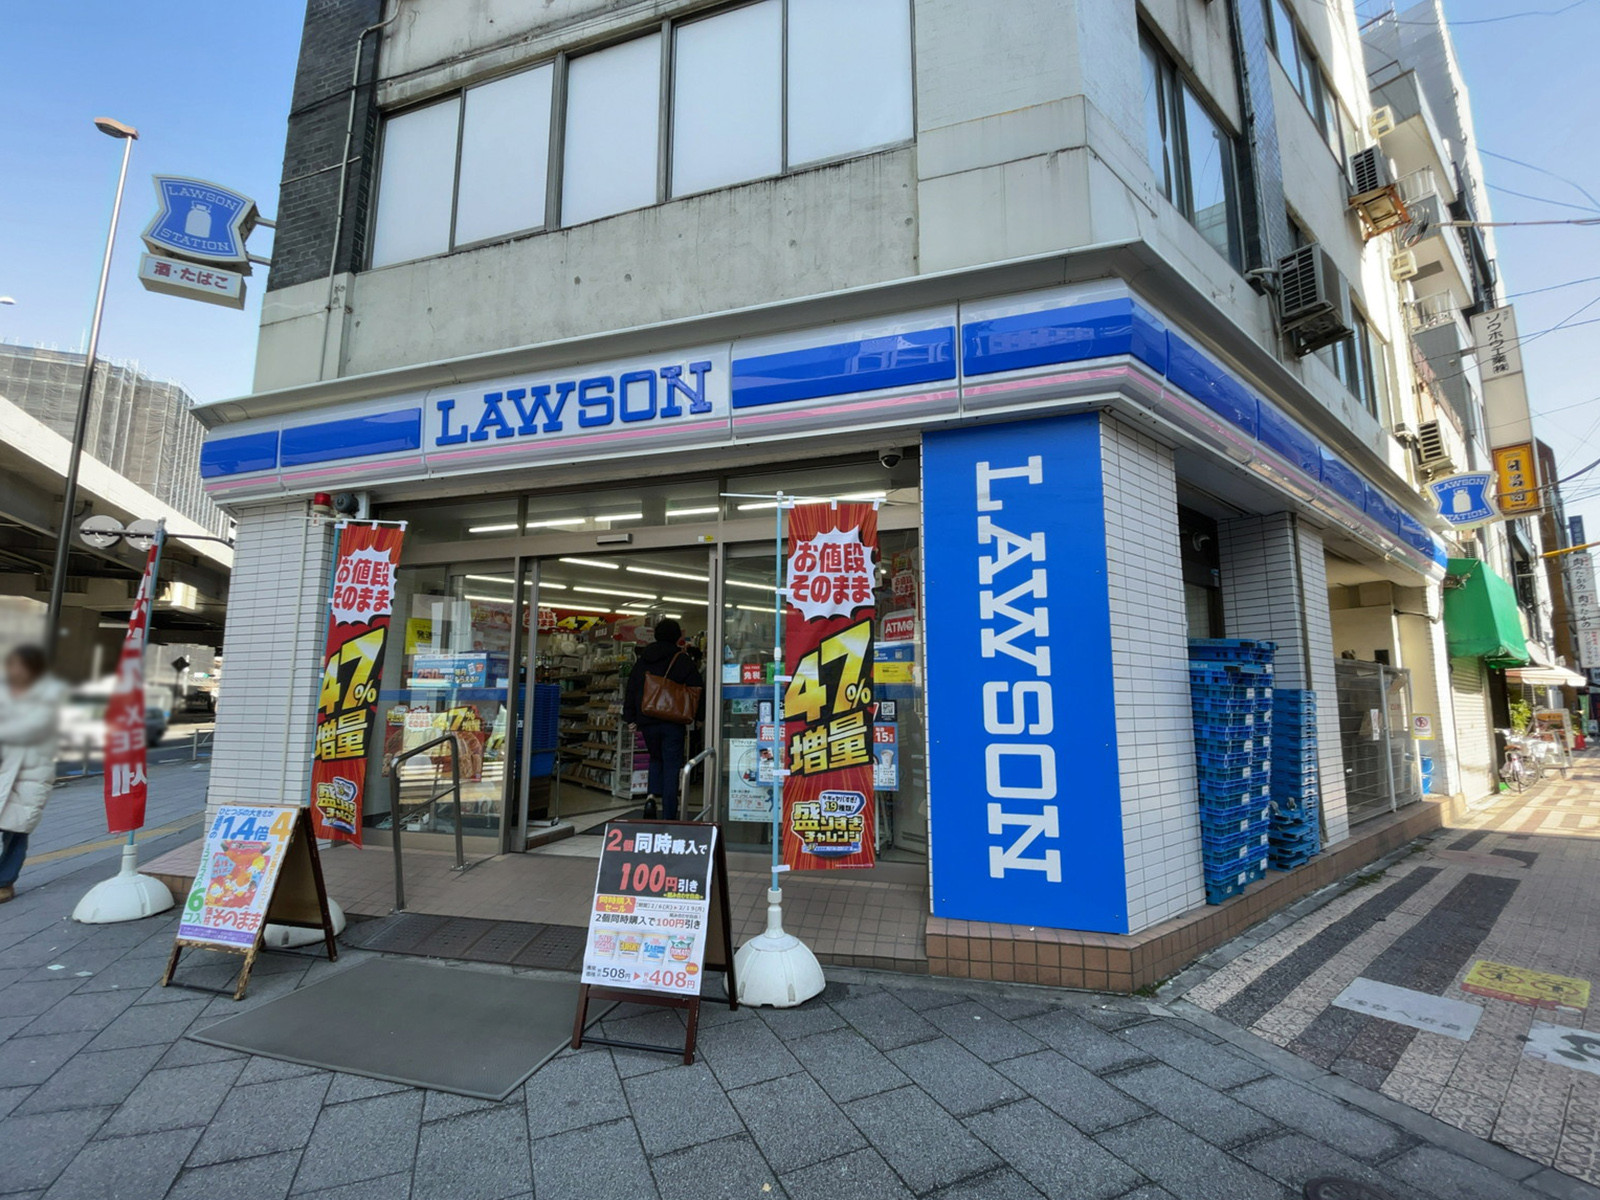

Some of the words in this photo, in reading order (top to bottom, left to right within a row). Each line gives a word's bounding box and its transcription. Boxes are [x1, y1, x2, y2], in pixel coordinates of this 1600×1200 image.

[168, 186, 238, 211] LAWSON
[160, 228, 229, 251] STATION
[153, 261, 228, 290] 酒・たばこ
[435, 360, 713, 446] LAWSON
[1435, 478, 1485, 492] LAWSON
[1446, 508, 1487, 520] TATION
[793, 542, 868, 573] お値段
[337, 558, 390, 587] お値段
[333, 585, 390, 613] そのまま
[790, 575, 871, 605] そのまま
[317, 627, 385, 715] 47%
[743, 671, 761, 680] 免税
[784, 620, 871, 722] 47%
[975, 455, 1062, 883] LAWSON
[314, 709, 368, 761] 増量
[790, 711, 870, 775] 増量
[794, 803, 863, 831] 盛りすぎ
[605, 829, 707, 855] 2個同時購入で
[804, 831, 860, 843] チャレンジ
[619, 863, 699, 892] 100円引き
[213, 909, 262, 931] そのまま
[595, 914, 701, 929] 2個同時購入で100円引き
[605, 904, 626, 913] セール
[602, 967, 631, 980] 508円
[650, 970, 695, 989] 408円
